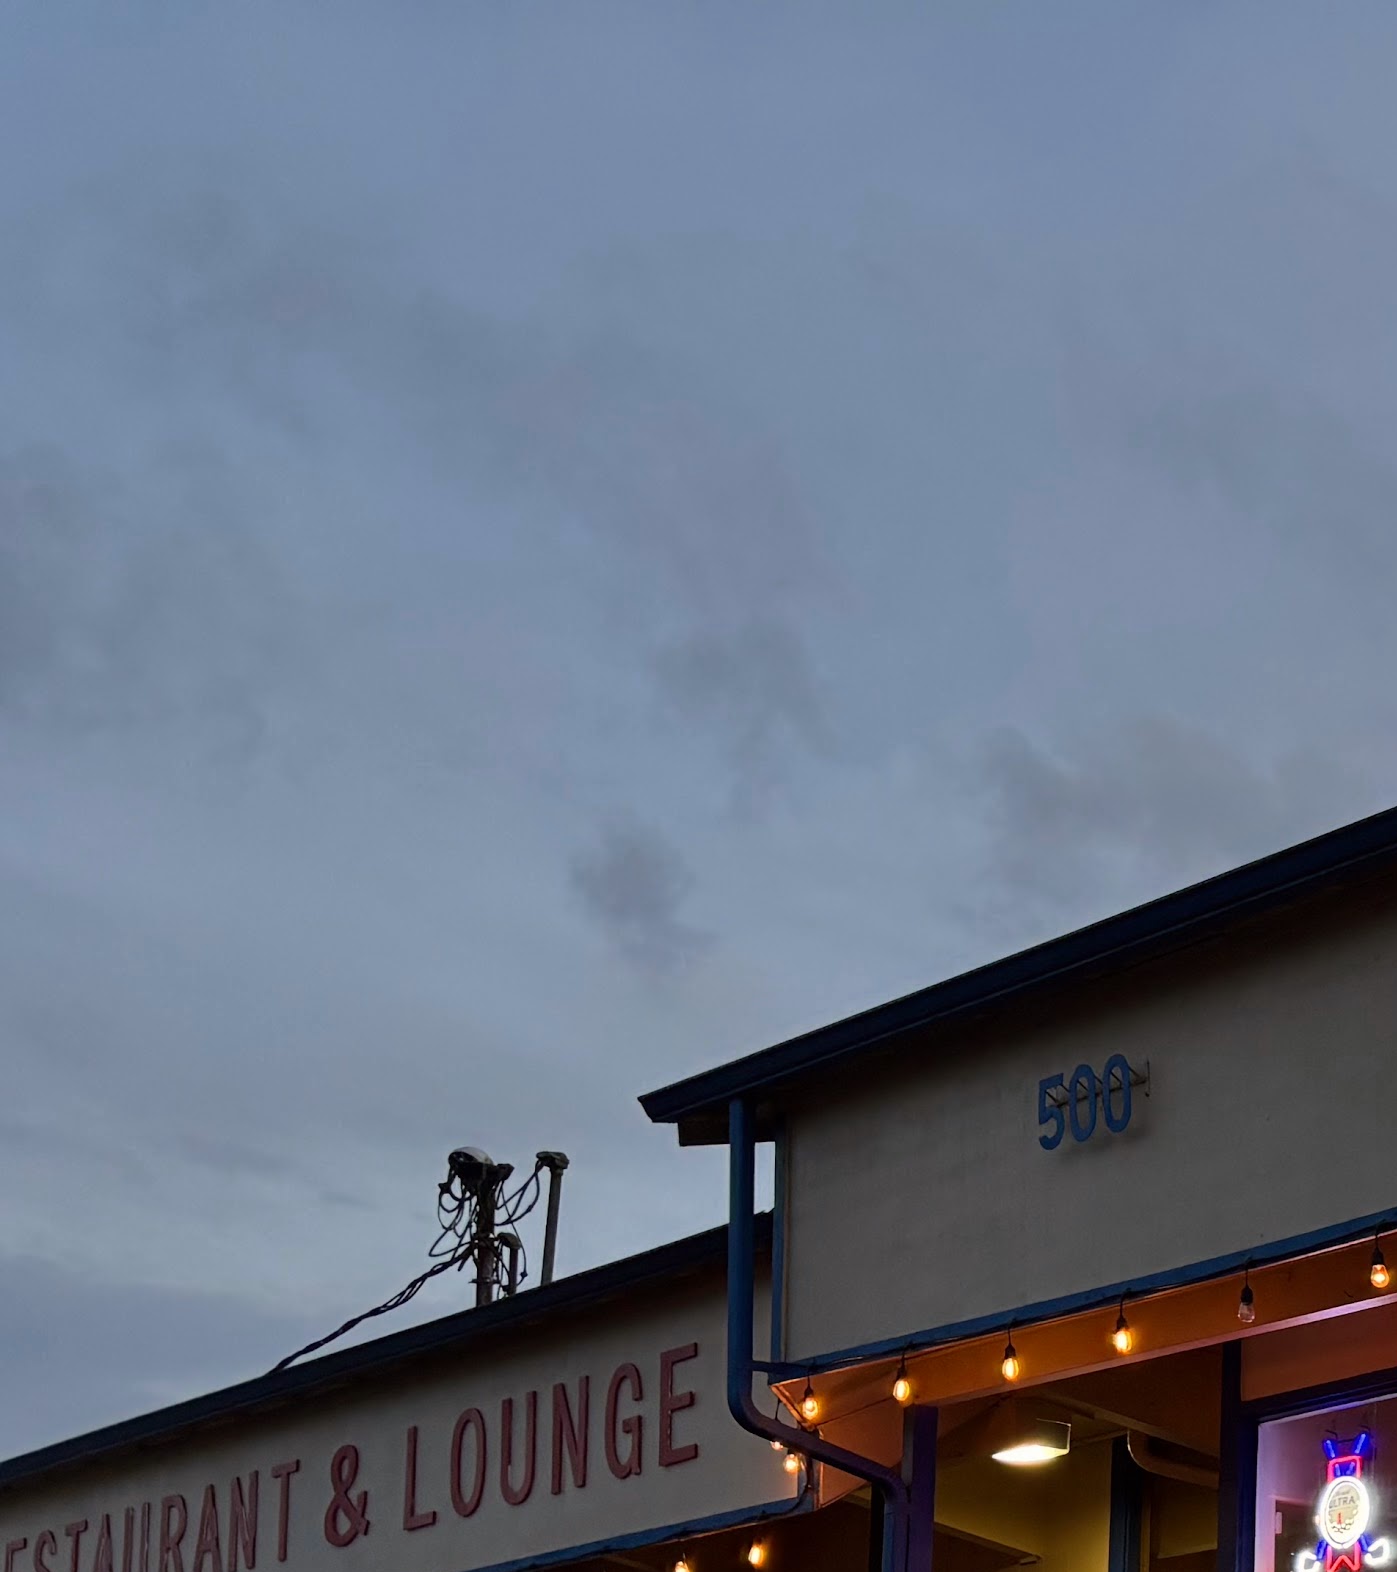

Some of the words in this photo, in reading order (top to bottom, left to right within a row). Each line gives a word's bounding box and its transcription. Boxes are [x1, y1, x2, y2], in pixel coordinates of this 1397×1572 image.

[1038, 1053, 1132, 1150] 500
[323, 1443, 371, 1548] &
[402, 1341, 699, 1531] LOUNGE
